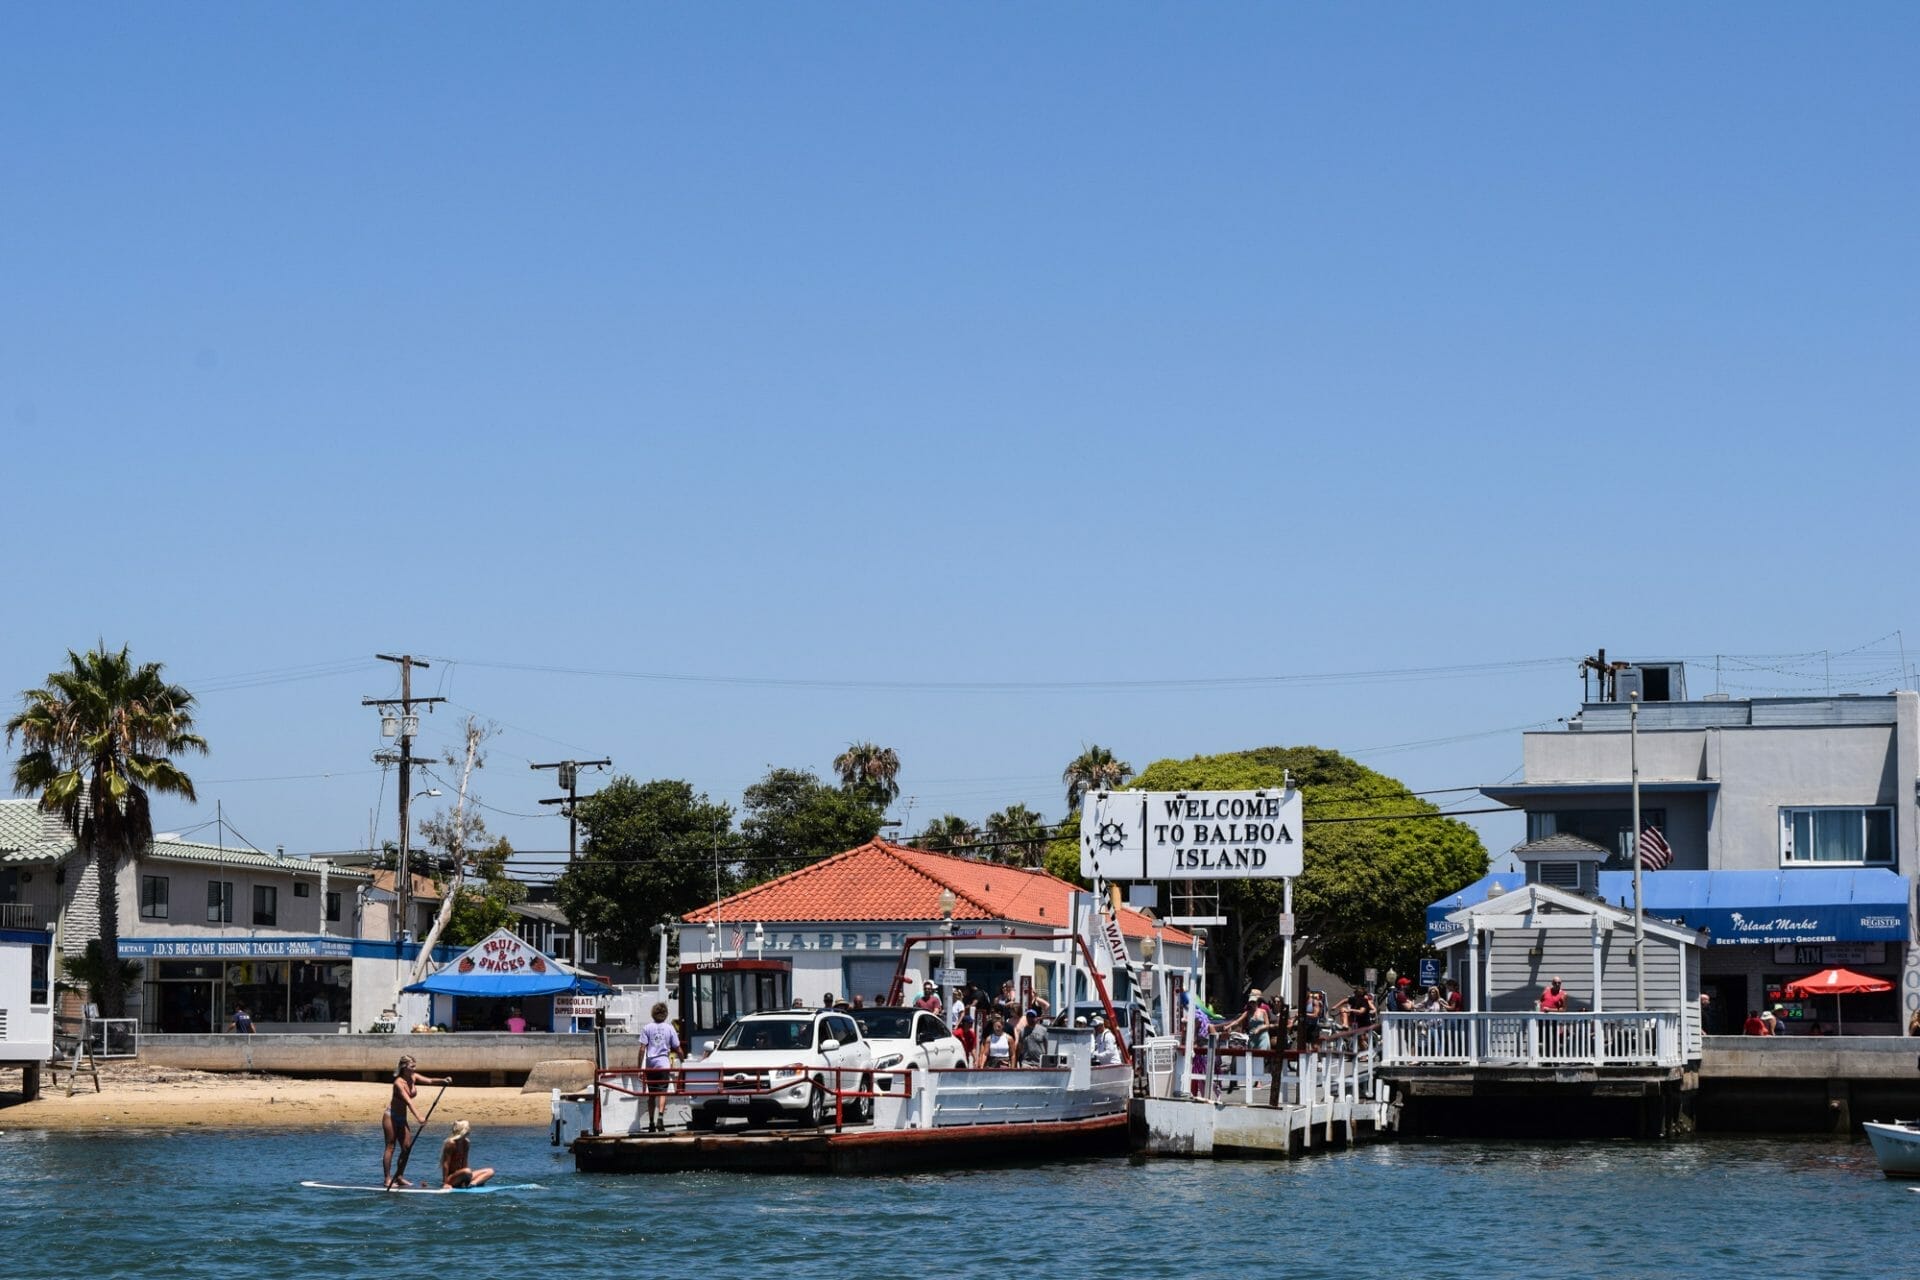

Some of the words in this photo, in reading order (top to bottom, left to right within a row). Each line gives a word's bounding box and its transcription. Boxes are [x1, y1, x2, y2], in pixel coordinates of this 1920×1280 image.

[1165, 799, 1279, 819] WELCOME
[1154, 824, 1185, 844] TO
[1193, 823, 1293, 843] BALBOA
[1175, 848, 1267, 868] ISLAND
[1428, 921, 1462, 931] REGIST
[1775, 918, 1818, 930] Market
[1860, 918, 1901, 926] REGISTER
[289, 941, 310, 949] MAIL
[1106, 923, 1127, 961] WAIT
[1795, 935, 1836, 943] GROCERIES
[118, 945, 147, 953] RETAIL
[175, 943, 190, 955] BIG
[191, 943, 216, 955] GAME
[218, 942, 251, 955] FISHING
[253, 942, 285, 954] TACKLE
[483, 939, 521, 954] FRUIT
[498, 950, 507, 961] &
[1797, 946, 1822, 964] ATM
[479, 956, 525, 972] SNACKS
[696, 962, 723, 970] CAPTAIN
[556, 997, 593, 1006] CHOCOLATE
